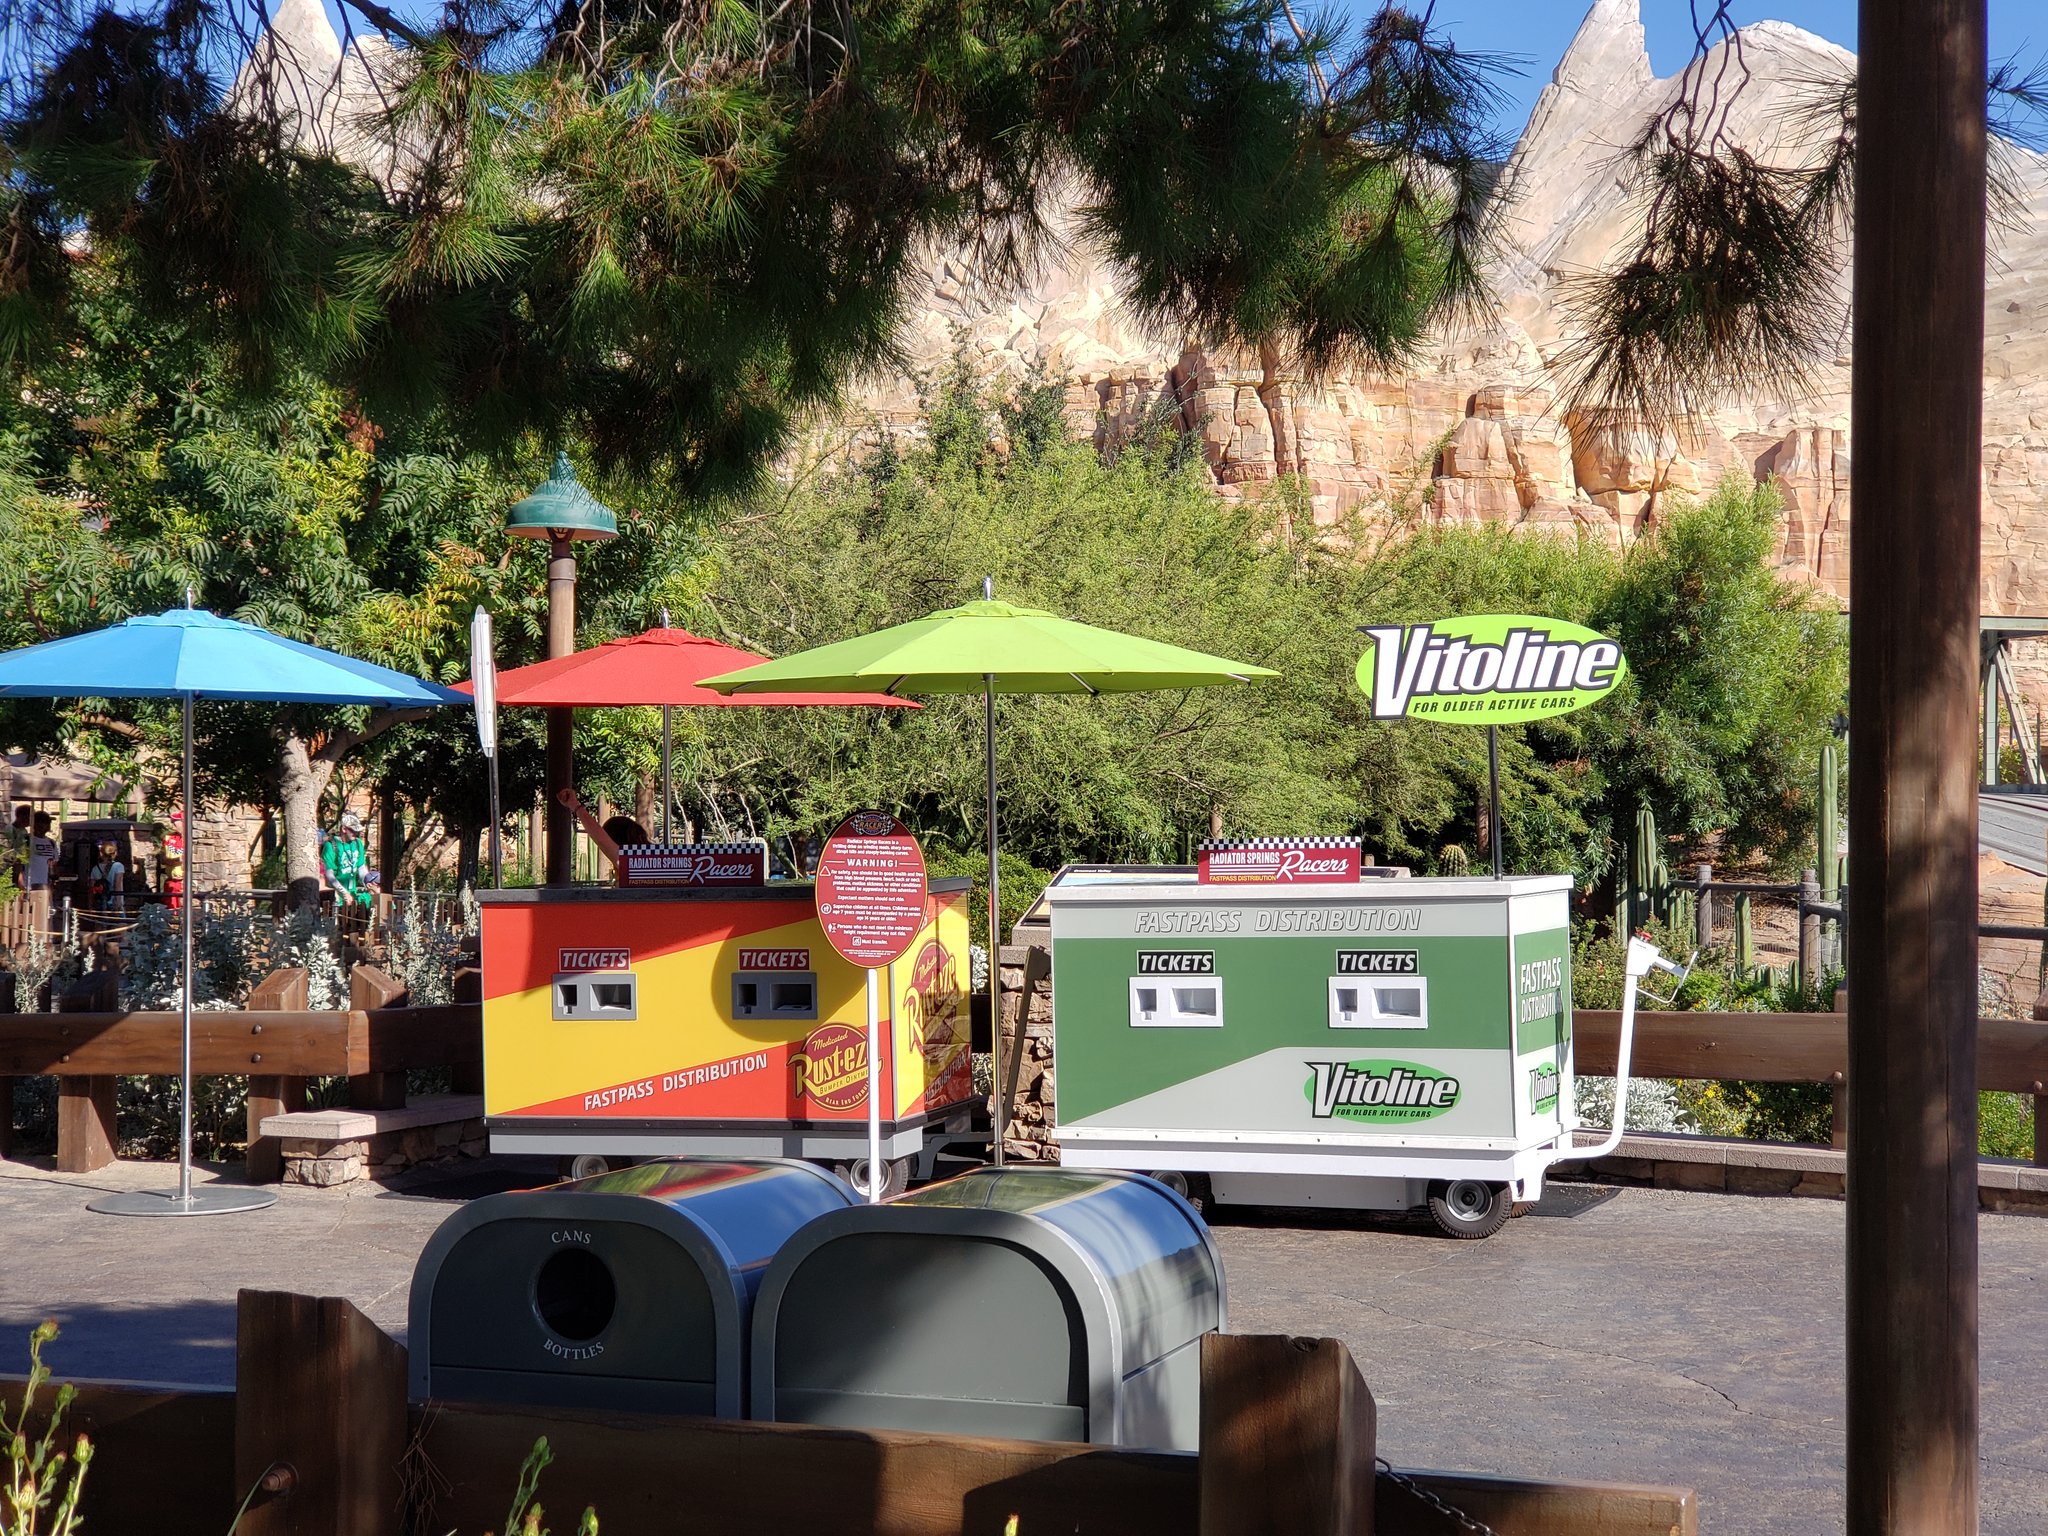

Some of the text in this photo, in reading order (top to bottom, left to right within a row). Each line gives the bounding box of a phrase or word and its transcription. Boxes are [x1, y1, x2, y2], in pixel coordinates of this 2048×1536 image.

[1357, 623, 1623, 720] Vitoline
[1413, 697, 1576, 713] FOR OLDER ACTIVE CARS
[628, 856, 754, 884] RADIATOR SPRINGS Racers
[847, 858, 898, 868] WARNING!
[1209, 850, 1349, 881] RADIATOR SPRINGS Racers
[1134, 908, 1422, 933] FASTPASS DISTRIBUTION
[562, 952, 628, 968] TICKETS
[741, 952, 808, 968] TICKETS
[1140, 954, 1212, 971] TICKETS
[1340, 953, 1415, 971] TICKETS
[1521, 957, 1561, 994] FASTPASS
[812, 1030, 848, 1051] Medicated
[787, 1040, 869, 1097] Rust-ez
[584, 1053, 768, 1111] FASTPASS DISTRIBUTION
[820, 1070, 868, 1094] BUMPER OINTM
[1304, 1061, 1460, 1118] Vitoline
[551, 1230, 592, 1244] CANS
[544, 1339, 604, 1360] BOTTLES
